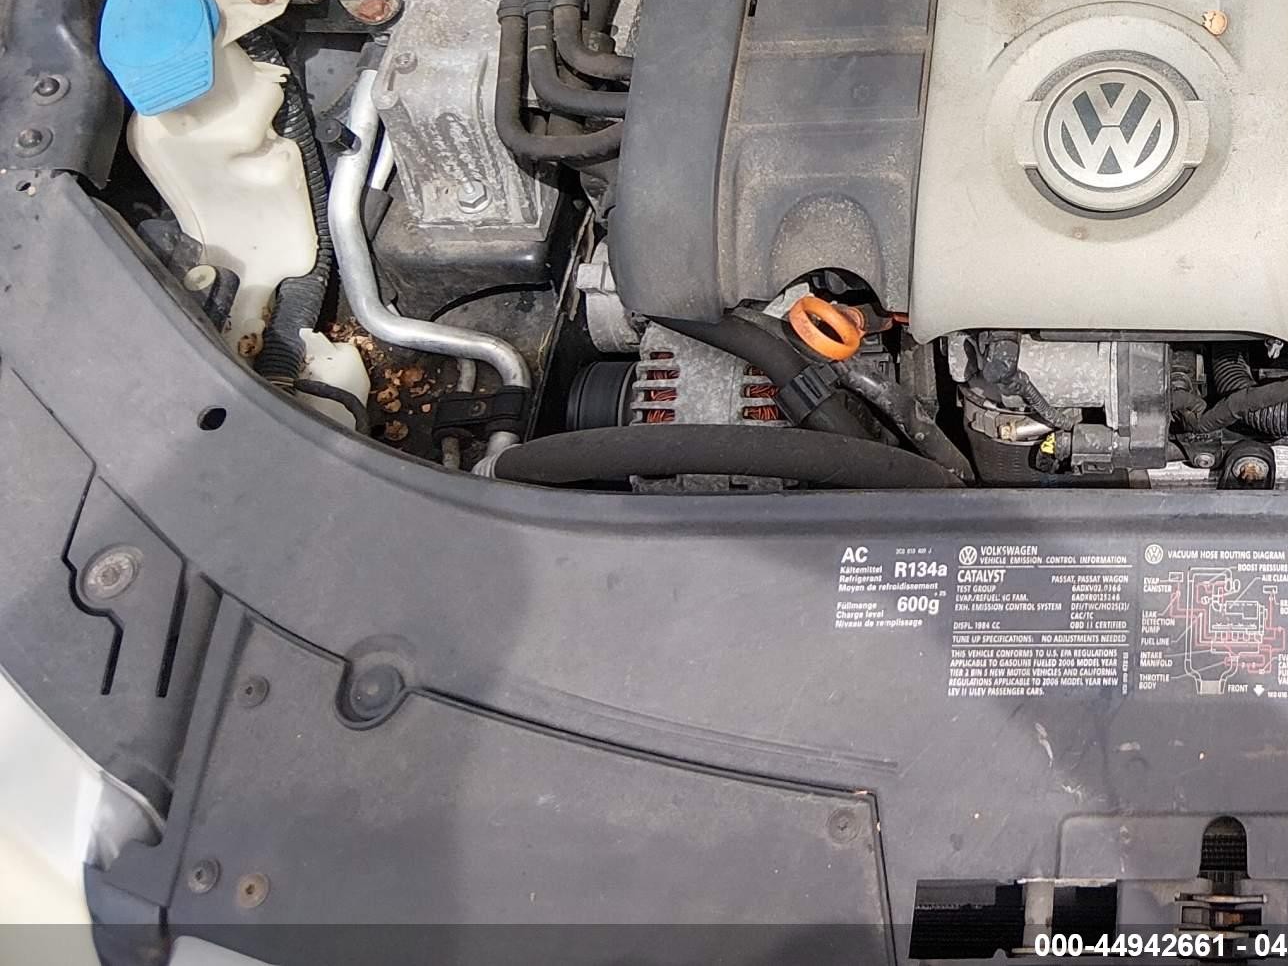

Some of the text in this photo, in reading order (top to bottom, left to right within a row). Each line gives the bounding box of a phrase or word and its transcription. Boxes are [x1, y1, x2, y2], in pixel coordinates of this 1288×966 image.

[841, 547, 868, 563] AC
[981, 546, 1038, 556] VOLKSWAGEN
[1168, 551, 1286, 559] VACUUM HOSE ROUTING DIAGRAM
[1046, 556, 1076, 564] CONTROL
[1080, 556, 1127, 564] INFORMATION
[895, 561, 948, 577] R134a
[840, 575, 882, 583] Refrigerant
[958, 570, 1006, 583] CATALYST
[1078, 576, 1101, 584] PASSAT
[1102, 576, 1129, 584] WAGON
[1262, 574, 1274, 582] AIR
[897, 596, 940, 615] 600g
[836, 611, 863, 620] Charge
[953, 635, 970, 643] TUNE
[972, 635, 980, 643] UP
[1042, 635, 1053, 643] NO
[1054, 635, 1100, 643] ADJUSTMENTS
[1101, 635, 1126, 643] NEEDED
[952, 650, 966, 658] THIS
[968, 650, 994, 658] VEHICLE
[996, 650, 1033, 658] CONFORMS
[1036, 650, 1044, 658] TO
[1061, 650, 1072, 658] EPA
[1074, 650, 1118, 658] REGULATIONS
[950, 659, 1118, 667] APPLICABLE TO GASOLINE FUELED 2006 MODEL YEAR
[950, 668, 964, 676] TIER
[971, 668, 982, 676] BIN
[990, 668, 1004, 676] NEW
[1007, 668, 1030, 676] MOTOR
[1032, 668, 1061, 676] VEHICLES
[1064, 668, 1078, 676] AND
[1080, 668, 1117, 676] CALIFORNIA
[949, 678, 992, 686] REGULATIONS
[994, 678, 1030, 686] APPLICABLE
[1032, 678, 1041, 686] TO
[1061, 678, 1084, 686] MODEL
[1085, 678, 1101, 686] YEAR
[1102, 678, 1118, 686] NEW
[948, 688, 960, 696] LEV
[969, 688, 986, 696] ULEV
[988, 688, 1024, 696] PASSENGER
[1026, 688, 1044, 696] CARS.
